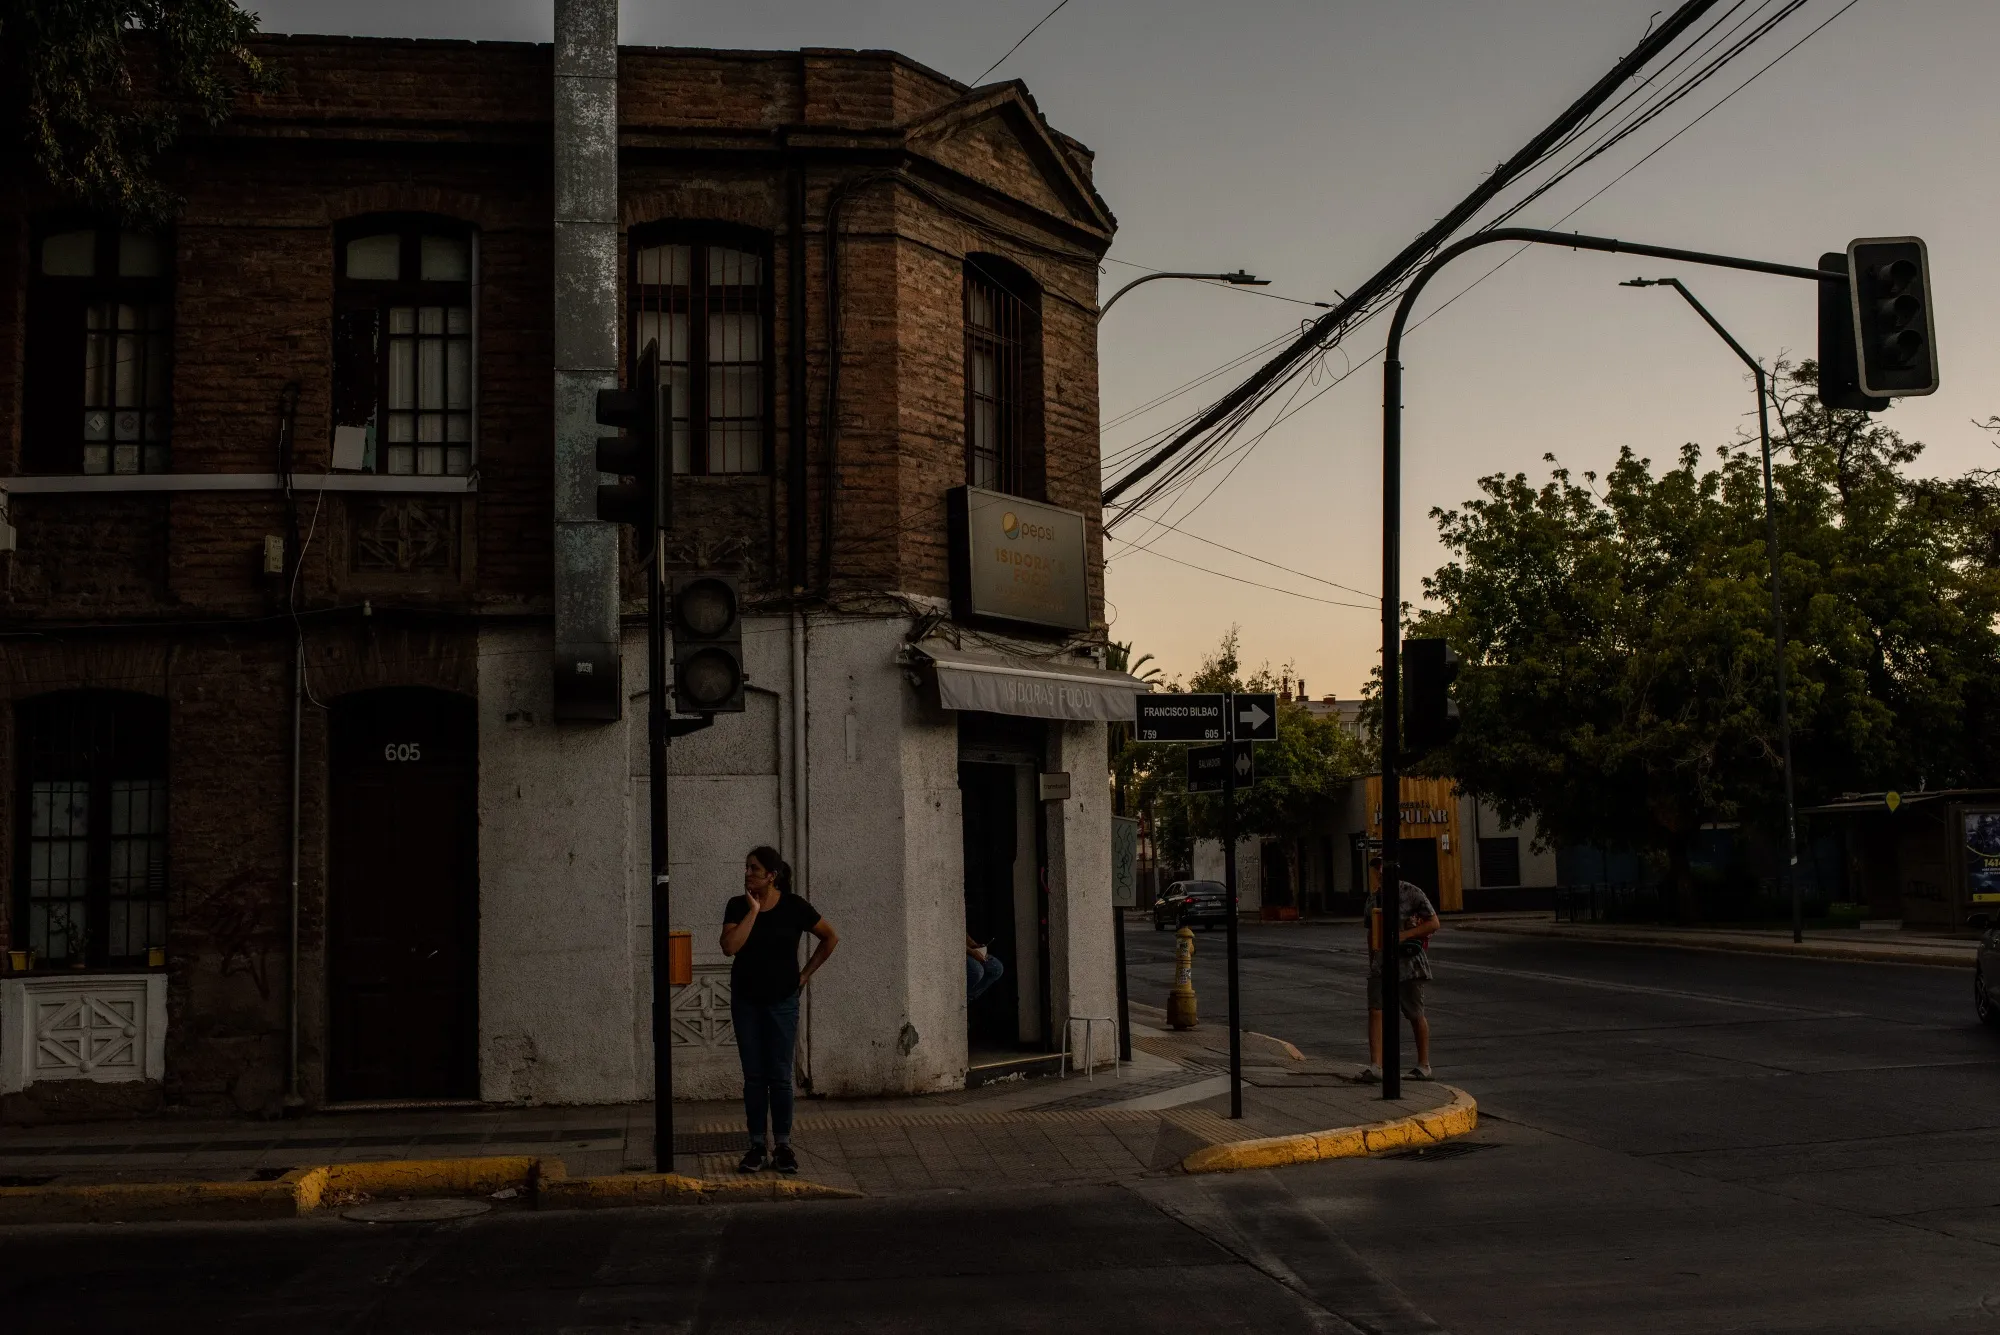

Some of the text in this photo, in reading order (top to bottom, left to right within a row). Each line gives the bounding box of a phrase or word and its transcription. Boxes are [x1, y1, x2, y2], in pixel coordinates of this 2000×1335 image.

[1021, 522, 1055, 542] pepsi
[1059, 686, 1092, 708] FOOD
[1144, 706, 1219, 717] FRANCISCO BILBAO
[1143, 728, 1219, 740] 759 605
[384, 743, 421, 762] 605
